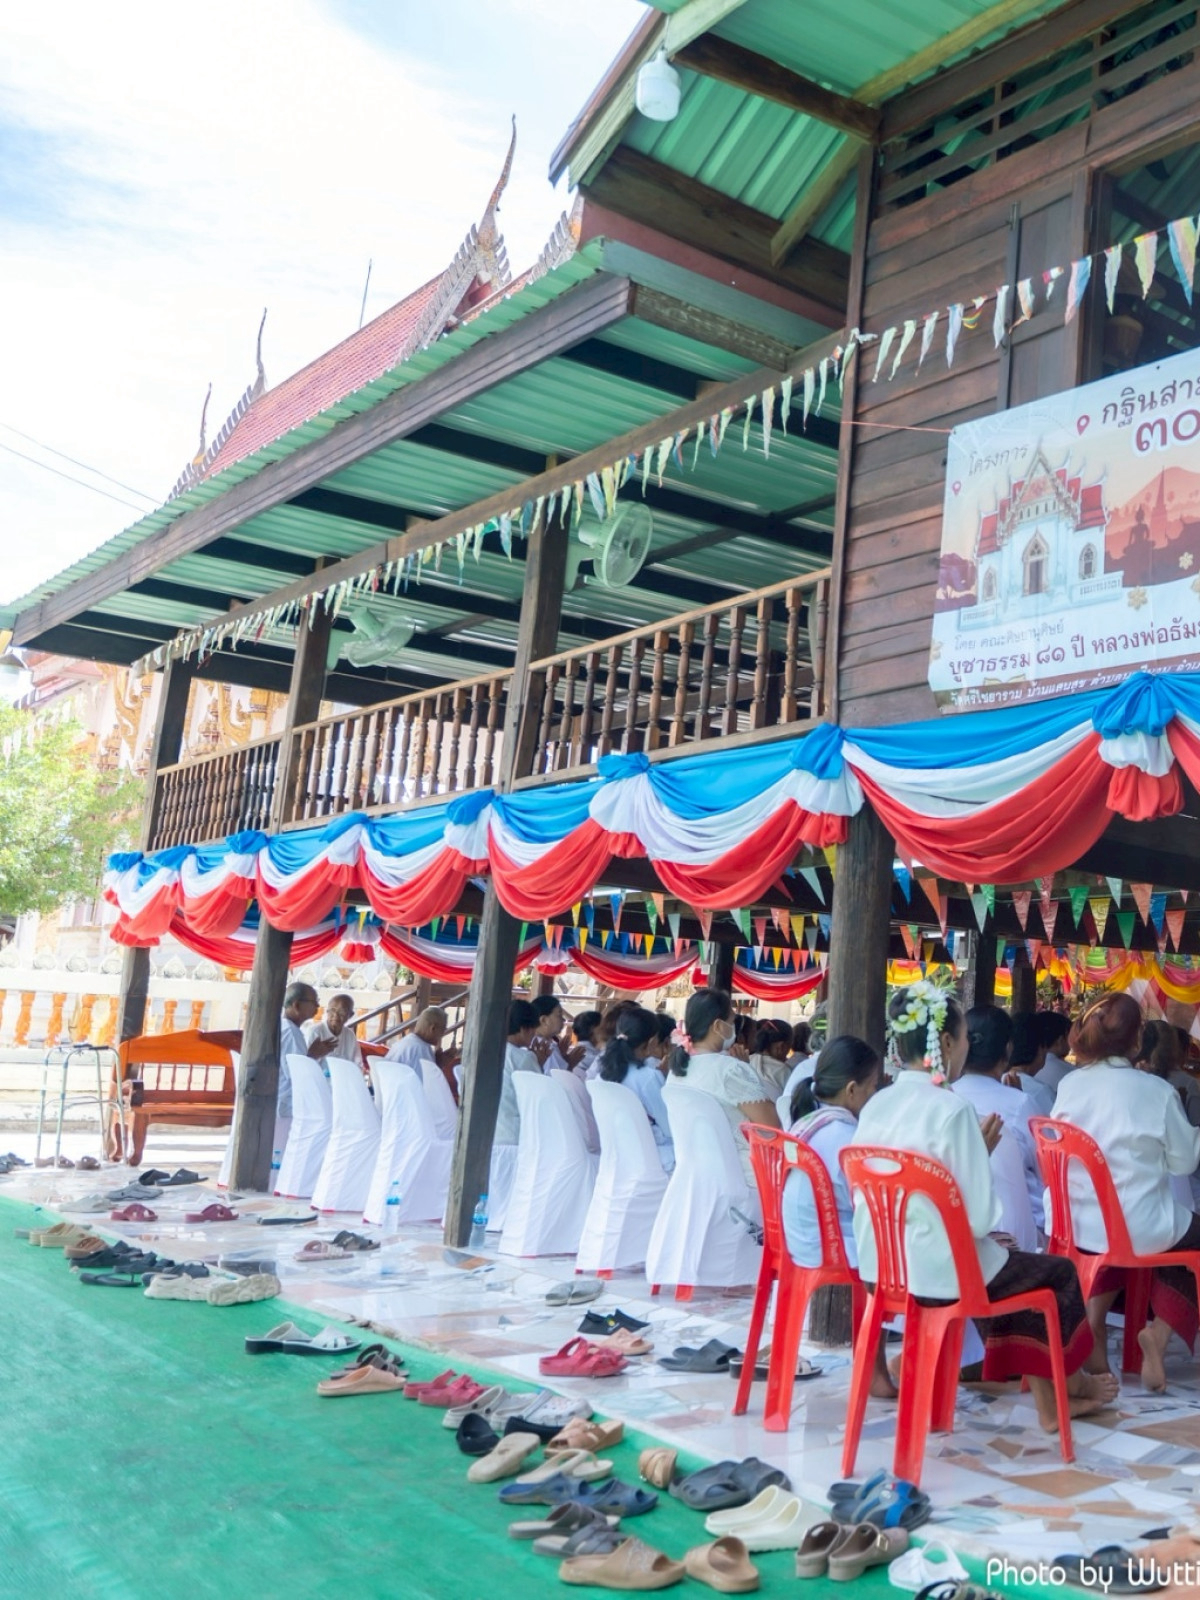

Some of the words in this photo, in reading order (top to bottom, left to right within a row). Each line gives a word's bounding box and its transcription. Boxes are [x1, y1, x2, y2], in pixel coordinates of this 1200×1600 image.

[969, 444, 1029, 476] โครงการ
[949, 652, 1031, 682] บูชาธรรม
[1036, 645, 1065, 665] ๘๑
[1070, 634, 1085, 658] ปี
